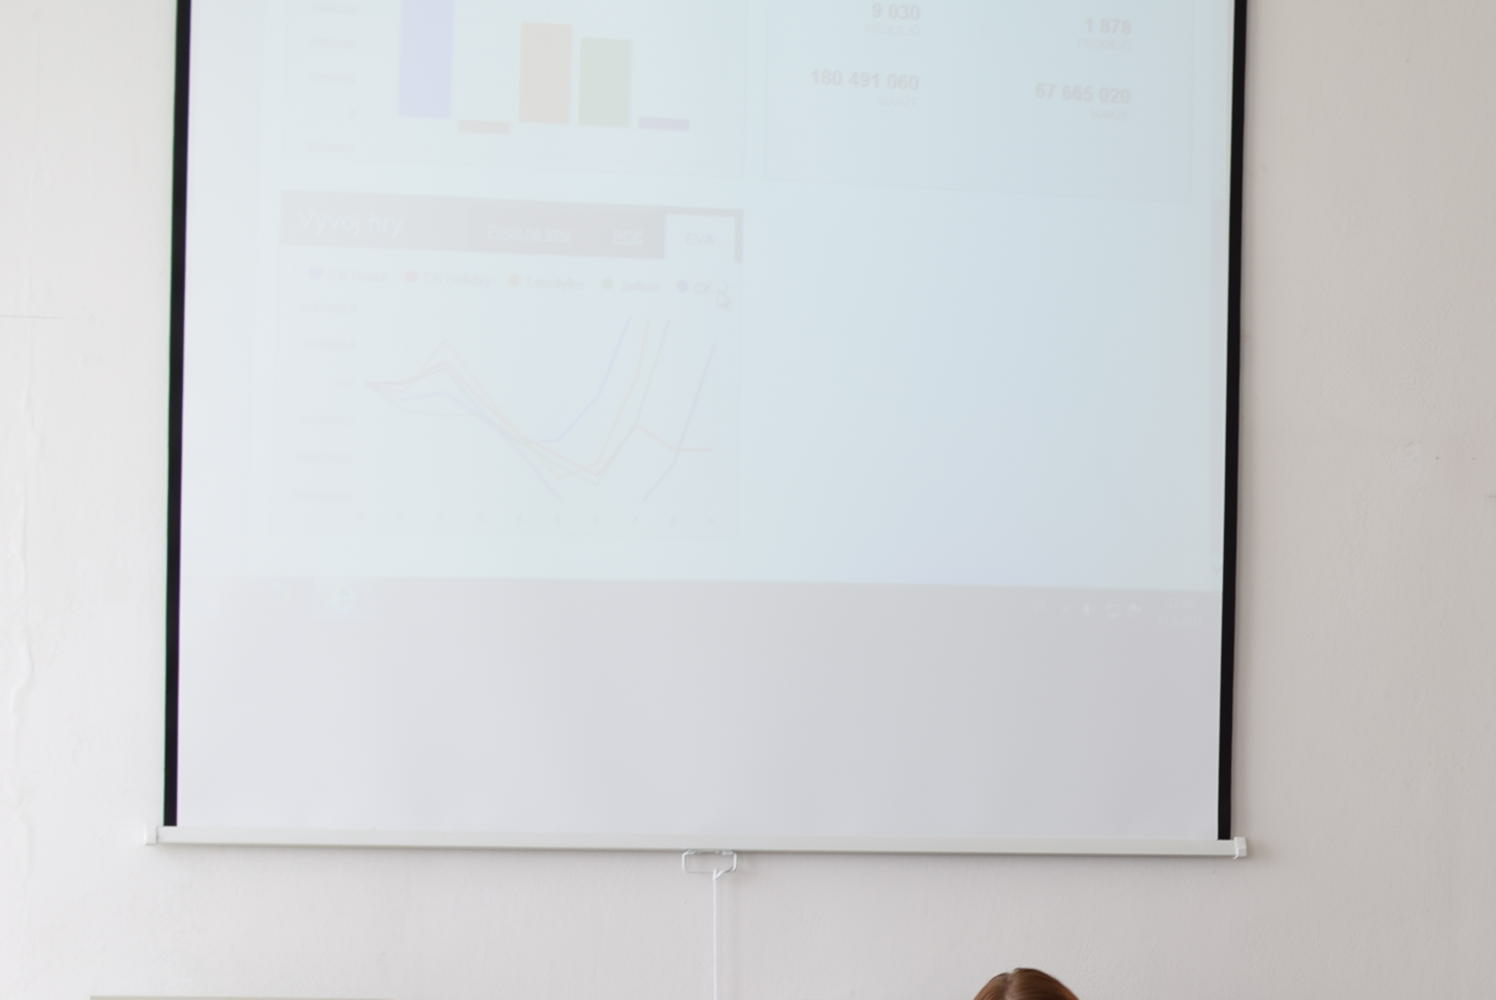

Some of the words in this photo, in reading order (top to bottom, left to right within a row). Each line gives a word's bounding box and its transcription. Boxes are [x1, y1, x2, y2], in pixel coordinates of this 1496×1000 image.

[887, 3, 921, 21] 030
[811, 67, 843, 87] 180
[848, 71, 880, 88] 491
[1035, 82, 1056, 99] 67
